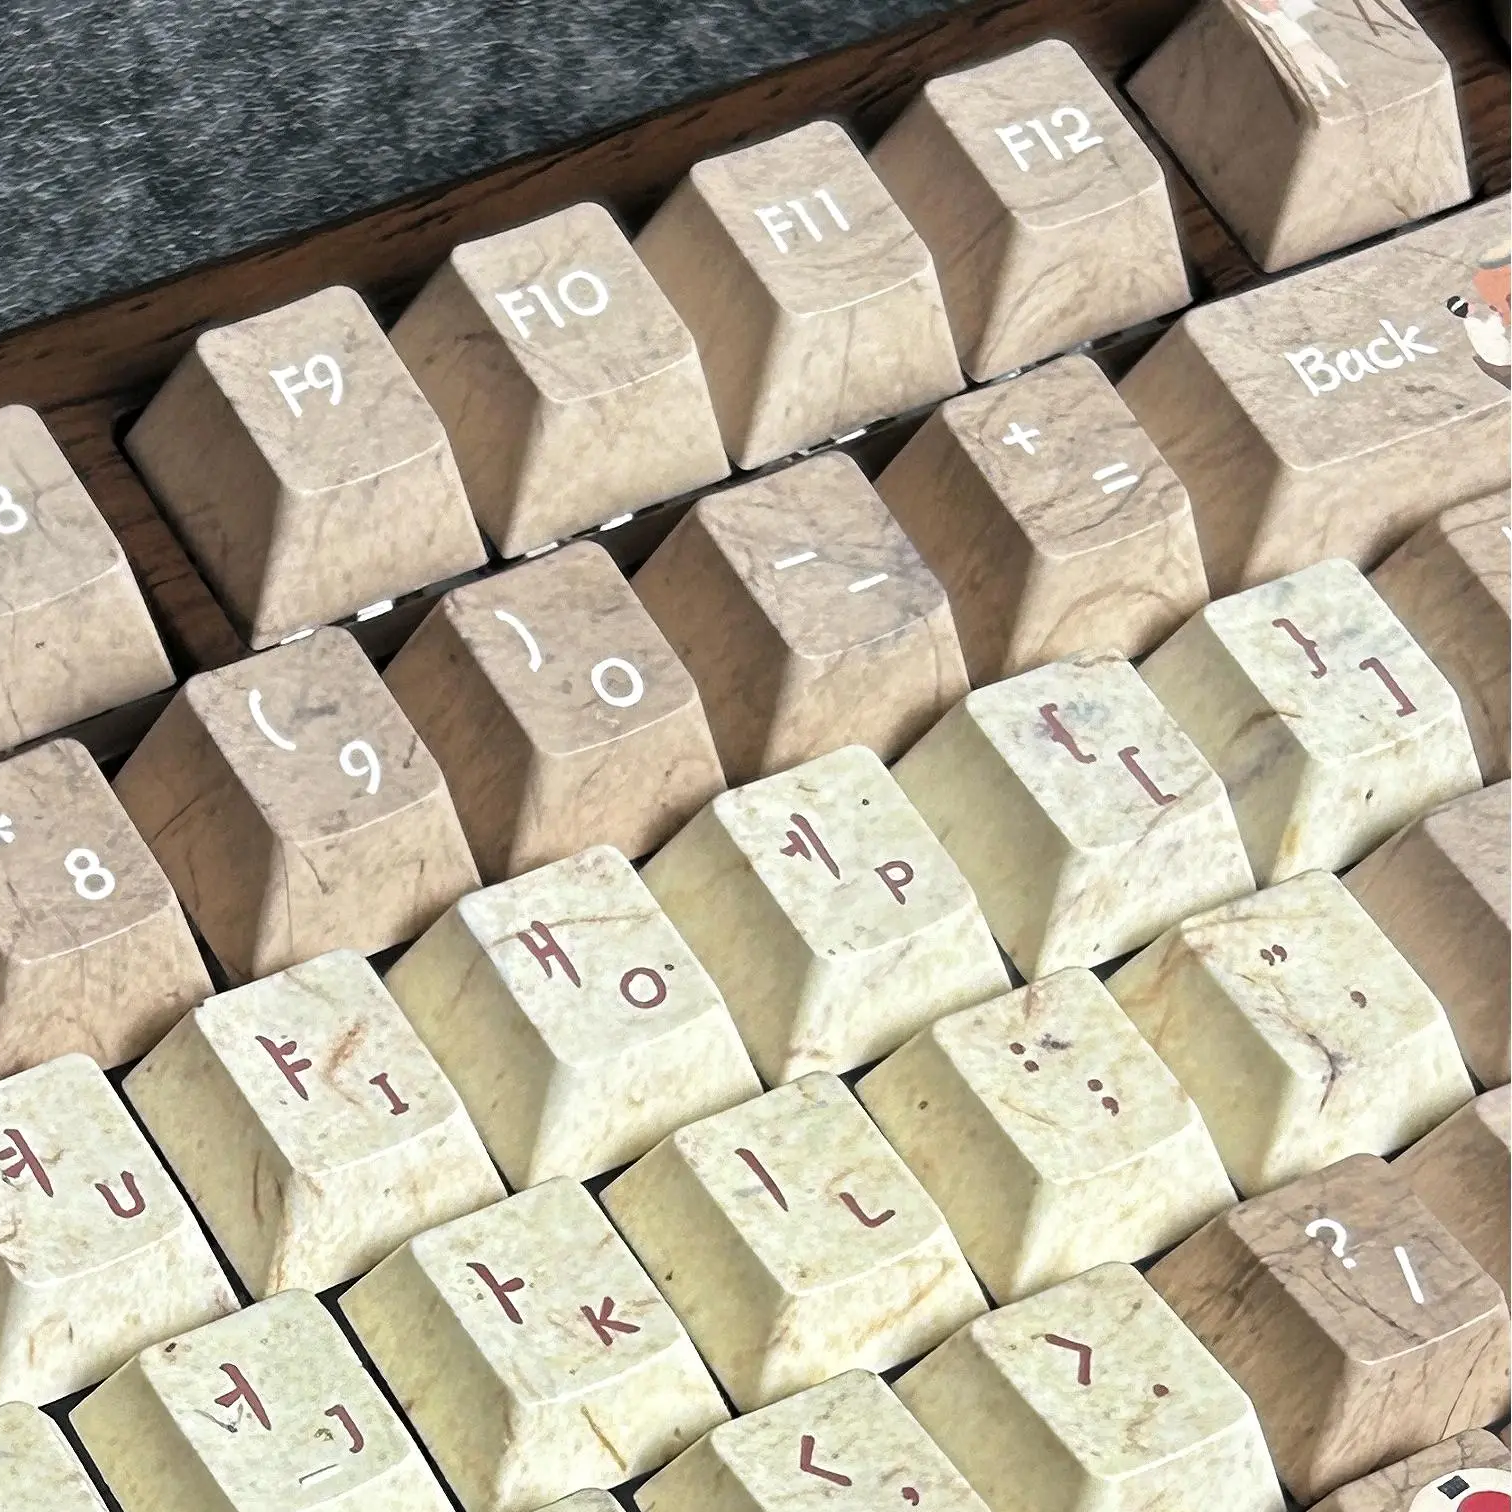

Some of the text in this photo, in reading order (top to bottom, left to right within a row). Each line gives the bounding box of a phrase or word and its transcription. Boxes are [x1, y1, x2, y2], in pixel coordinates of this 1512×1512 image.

[994, 105, 1104, 172] F12
[753, 188, 851, 254] F11
[496, 269, 610, 339] F10
[269, 354, 344, 418] F9
[1284, 318, 1438, 398] Back
[1001, 421, 1041, 455] +
[1092, 461, 1140, 495] =
[496, 609, 542, 672] )
[1271, 618, 1328, 679] }
[1358, 656, 1418, 718] ]
[249, 689, 297, 752] (
[1040, 702, 1097, 764] {
[338, 741, 382, 795] 9
[1118, 746, 1178, 805] [
[63, 848, 116, 900] 8
[874, 859, 914, 905] P
[516, 920, 582, 989] ㅐ
[254, 1035, 312, 1100] ㅑ
[1009, 1041, 1040, 1074] :
[368, 1072, 409, 1115] I
[1087, 1078, 1120, 1116] ;
[94, 1170, 146, 1219] U
[839, 1192, 896, 1229] L
[1304, 1218, 1357, 1269] ?
[466, 1262, 525, 1324] ㅏ
[579, 1296, 640, 1346] K
[214, 1362, 272, 1431] ㅓ
[322, 1404, 366, 1453] J
